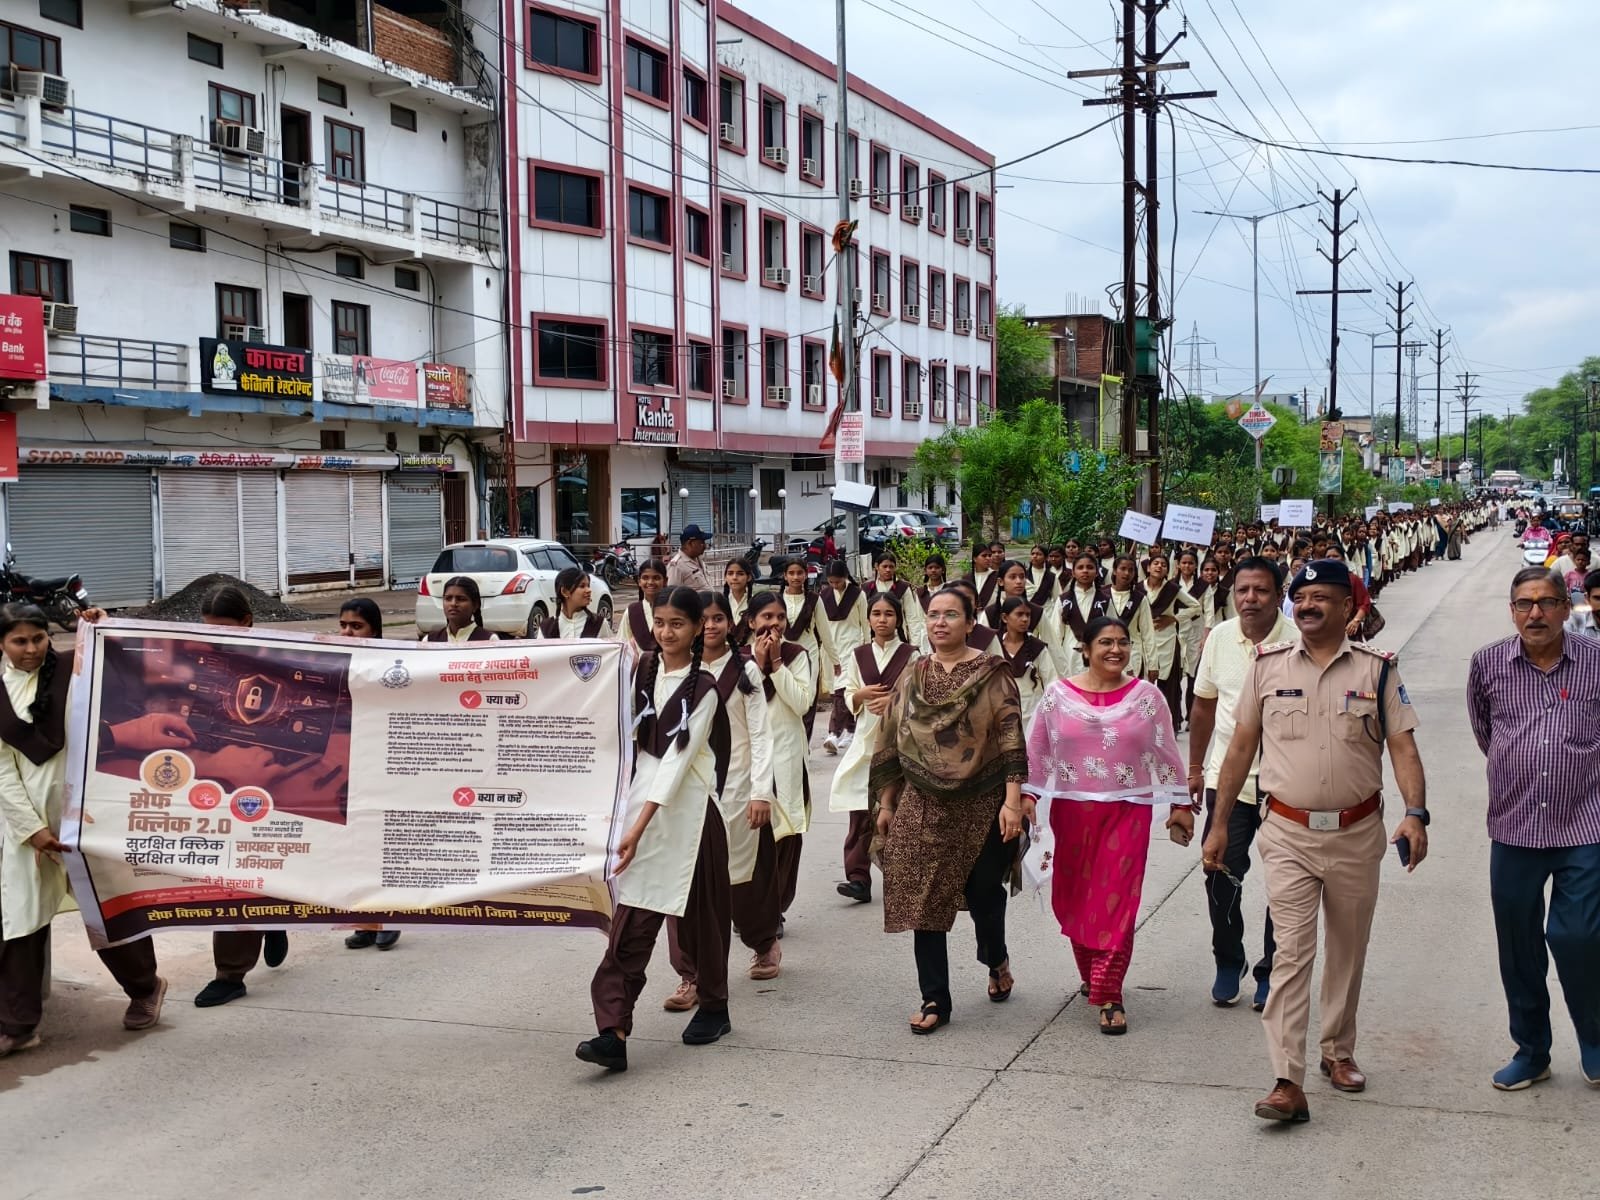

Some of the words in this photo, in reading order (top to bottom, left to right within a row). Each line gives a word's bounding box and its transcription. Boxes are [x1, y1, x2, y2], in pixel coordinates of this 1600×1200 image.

[2, 341, 24, 353] Bank
[245, 348, 305, 373] कान्हा
[241, 372, 274, 393] फैमिली
[638, 405, 674, 428] Kanha
[634, 427, 680, 443] International
[27, 449, 73, 464] STOP
[83, 450, 125, 464] SHOP
[448, 660, 483, 670] सायबर
[484, 658, 518, 670] अपराध
[519, 656, 531, 669] से
[440, 672, 465, 683] बचाव
[466, 671, 482, 684] हेतु
[483, 669, 539, 682] सावधानियां
[486, 694, 503, 705] क्या
[504, 693, 521, 705] करें
[129, 788, 172, 809] सेफ
[478, 793, 495, 803] क्या
[496, 793, 506, 803] न
[507, 791, 522, 803] करें
[127, 811, 192, 833] क्लिक
[196, 818, 232, 834] 2.0
[125, 835, 178, 852] सुरक्षित
[179, 835, 225, 852] क्लिक
[235, 840, 275, 854] सायबर
[277, 841, 311, 857] सुरक्षा
[124, 850, 175, 866] सुरक्षित
[178, 851, 220, 867] जीवन
[235, 855, 285, 871] अभियान
[226, 877, 255, 889] सुरक्षा
[257, 877, 265, 889] है
[146, 909, 174, 921] सेफ
[175, 907, 213, 920] क्लिक
[217, 908, 238, 918] 2.0
